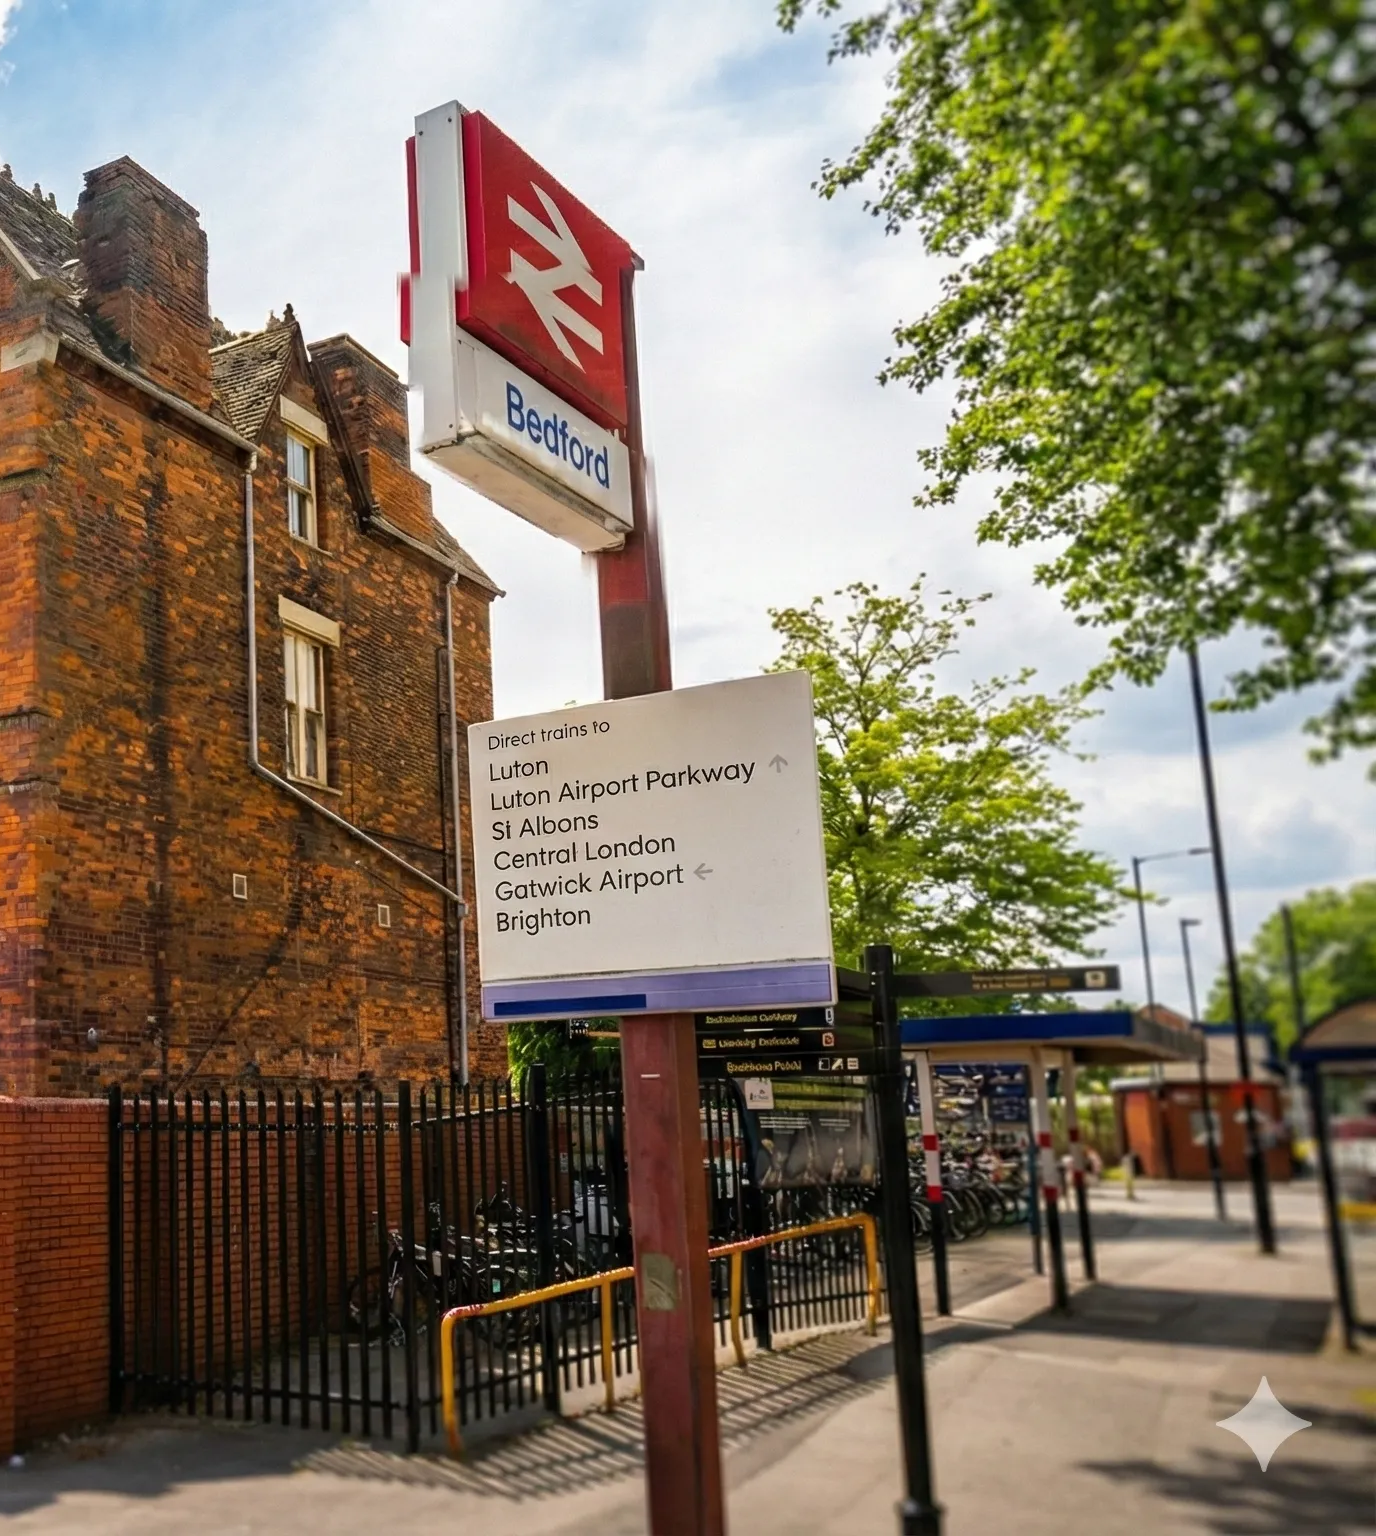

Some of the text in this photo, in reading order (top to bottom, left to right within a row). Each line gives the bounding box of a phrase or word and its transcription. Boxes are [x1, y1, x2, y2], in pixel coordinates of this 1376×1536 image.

[505, 381, 610, 489] Bedford
[488, 731, 536, 750] Direct
[541, 723, 588, 742] trains
[489, 760, 549, 781] Luton
[491, 761, 756, 811] Luton Airport Parkway
[493, 835, 676, 871] Central London
[495, 863, 685, 902] Gatwick Airport
[496, 907, 591, 936] Brighton
